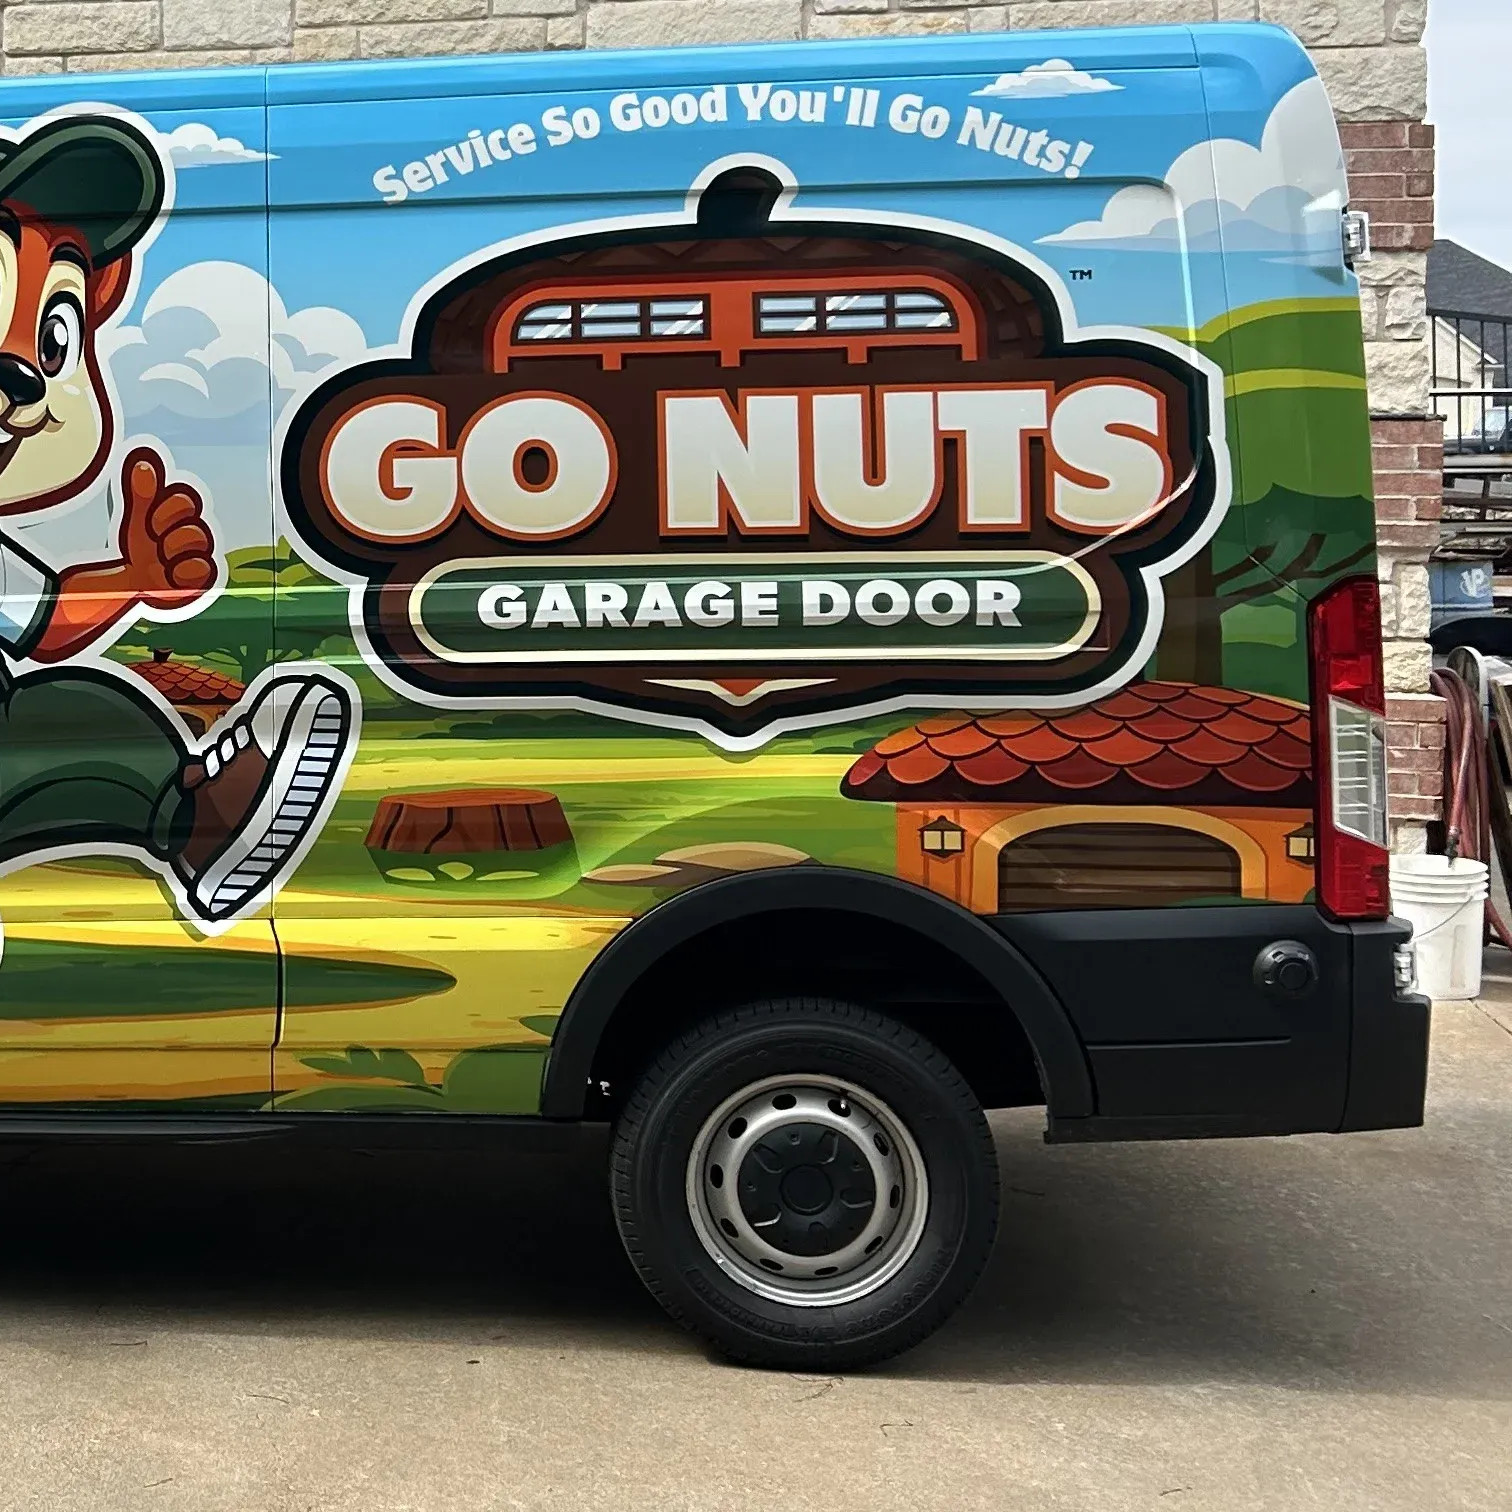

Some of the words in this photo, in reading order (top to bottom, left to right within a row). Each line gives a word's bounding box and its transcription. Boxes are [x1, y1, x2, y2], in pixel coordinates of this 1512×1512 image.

[372, 122, 537, 204] Service
[541, 106, 600, 147] So
[609, 84, 728, 132] Good
[737, 83, 880, 128] You'll
[889, 93, 950, 139] Go
[956, 105, 1094, 180] Nuts!
[320, 391, 616, 541] GO
[658, 379, 1172, 536] NUTS
[476, 580, 780, 630] GARAGE
[801, 578, 1023, 627] DOOR
